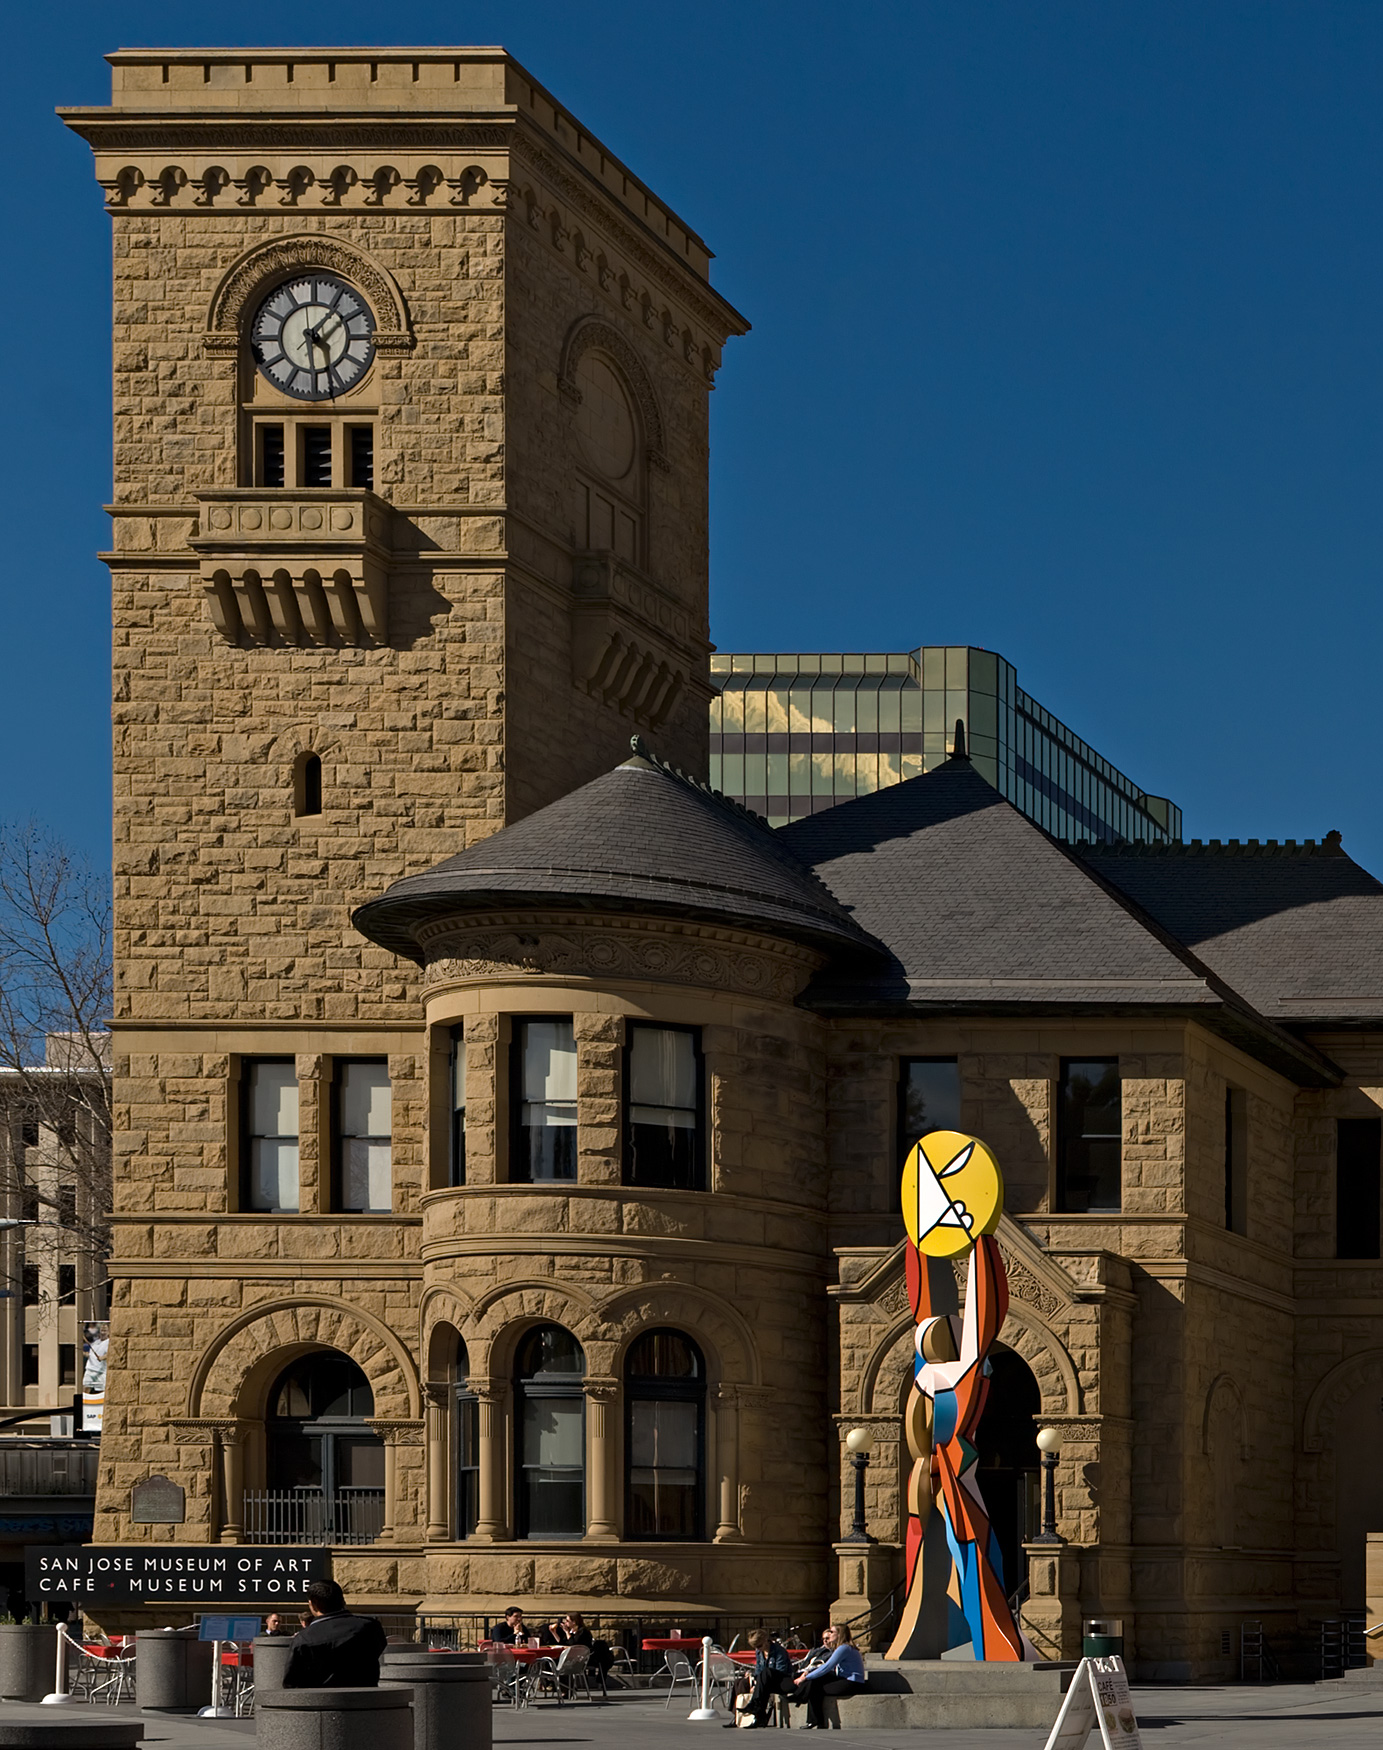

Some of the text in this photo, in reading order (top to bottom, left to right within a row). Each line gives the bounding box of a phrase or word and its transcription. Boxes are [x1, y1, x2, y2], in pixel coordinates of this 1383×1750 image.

[39, 1557, 313, 1575] SAN JOSE MUSEUM OF ART
[39, 1578, 311, 1593] CAFE MUSEUM STORE
[1097, 1677, 1114, 1692] CAFÉ
